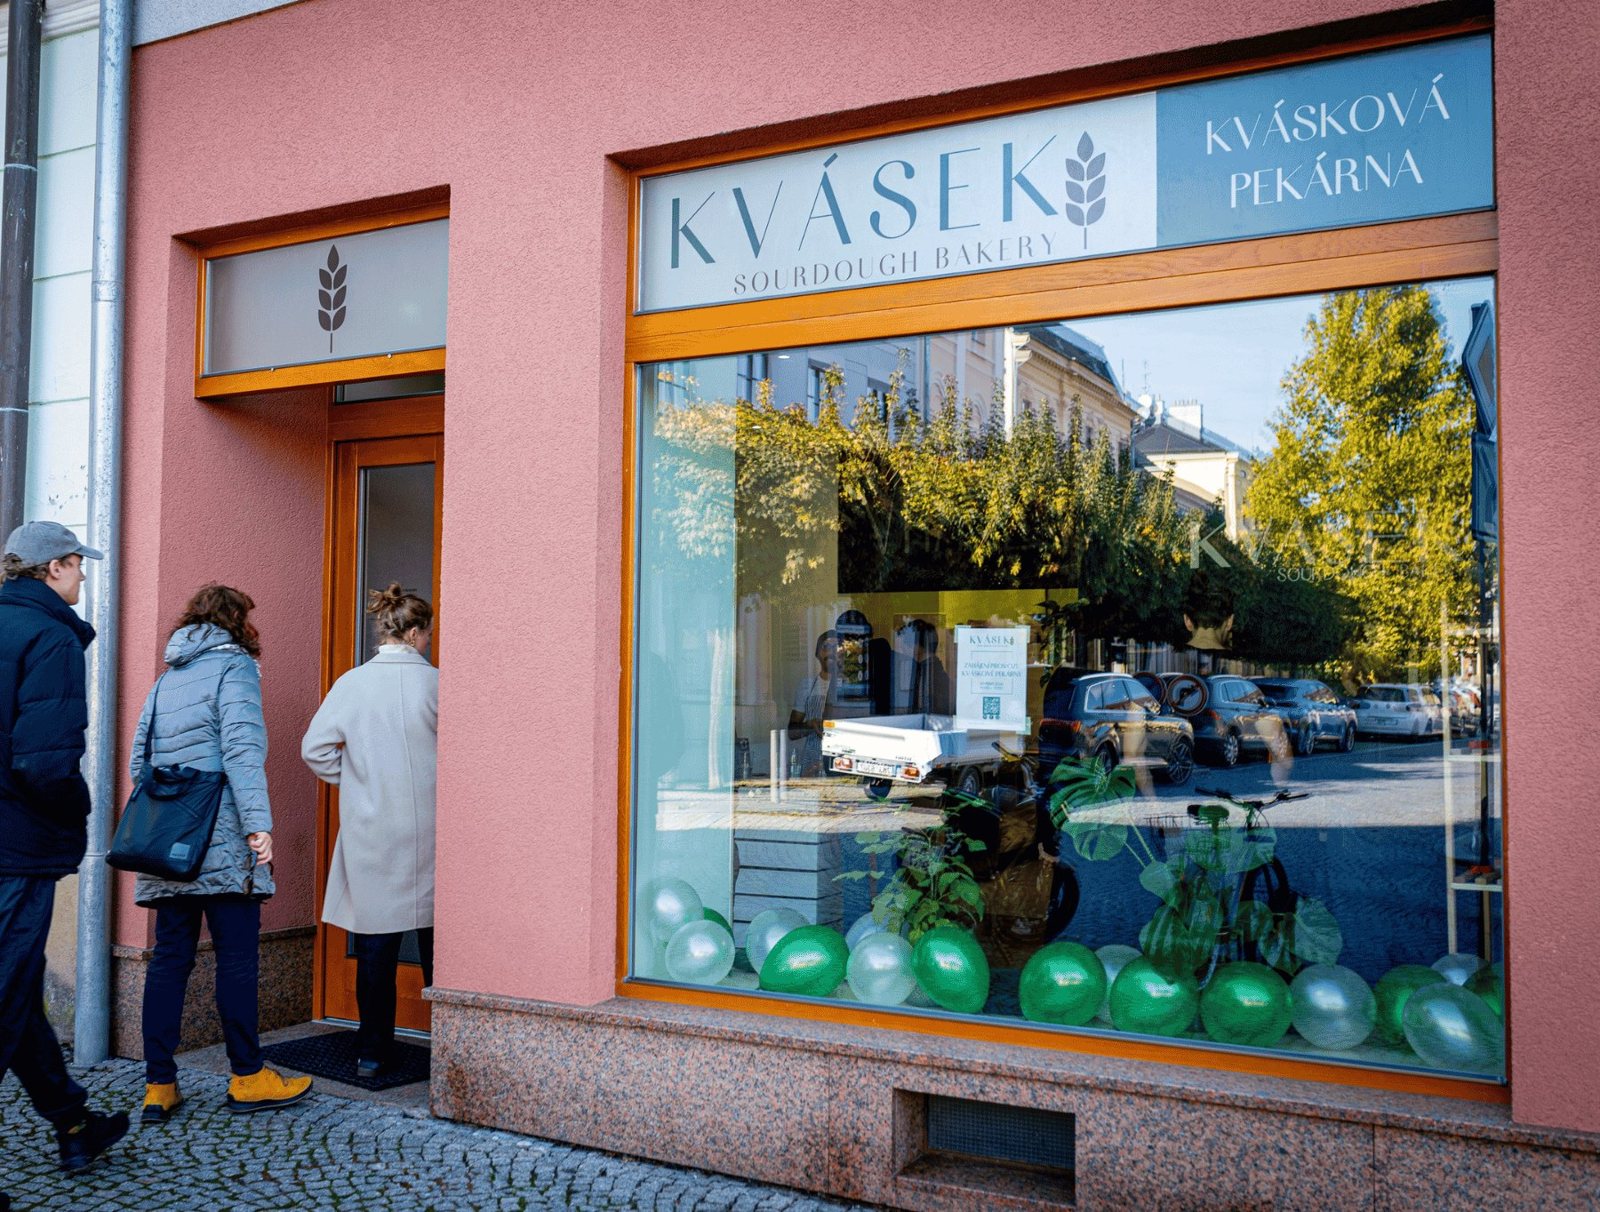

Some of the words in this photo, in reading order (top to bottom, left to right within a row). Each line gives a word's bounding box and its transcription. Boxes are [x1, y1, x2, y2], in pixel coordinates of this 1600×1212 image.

[1206, 72, 1450, 155] KVÁSKOVÁ
[670, 134, 1059, 269] KVÁSEK
[1230, 149, 1424, 208] PEKÁRNA
[733, 250, 918, 295] SOURDOUGH
[935, 231, 1057, 270] BAKERY
